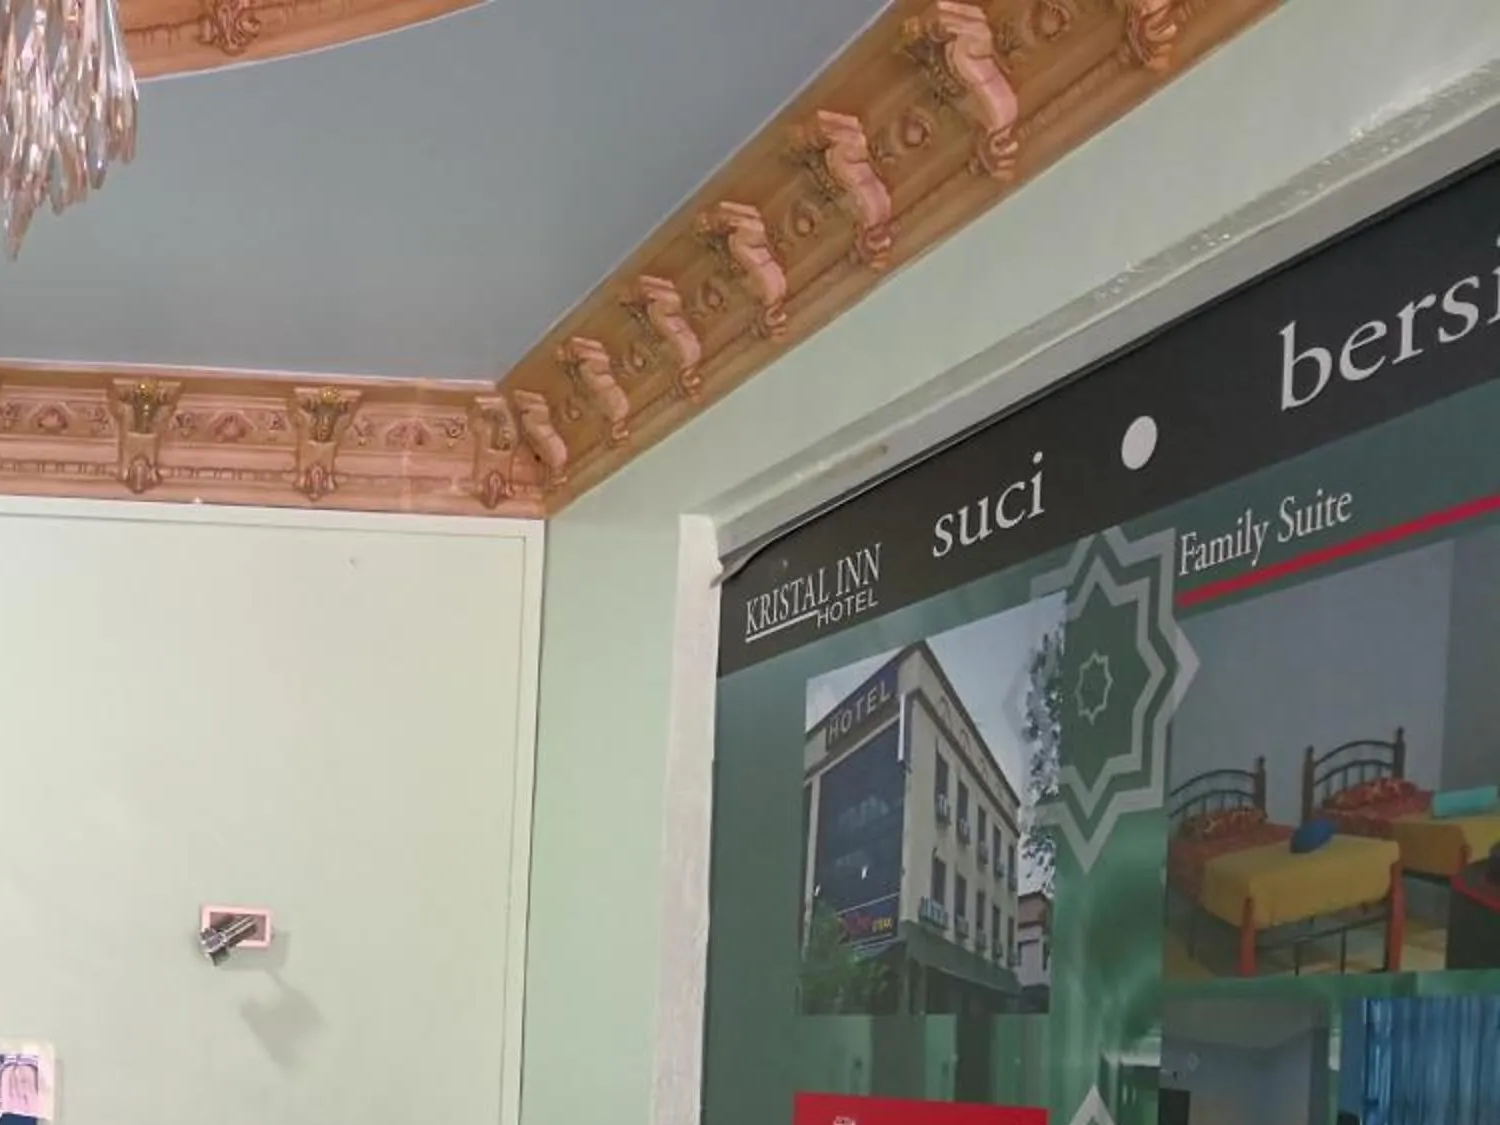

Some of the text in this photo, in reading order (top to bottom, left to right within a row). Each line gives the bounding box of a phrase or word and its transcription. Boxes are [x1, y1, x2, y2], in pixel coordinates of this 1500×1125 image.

[932, 451, 1046, 558] suci
[1178, 489, 1353, 576] Family Suite
[746, 542, 881, 634] KRISTAL INN
[817, 588, 878, 629] HOTEL
[826, 681, 892, 741] HOTEL
